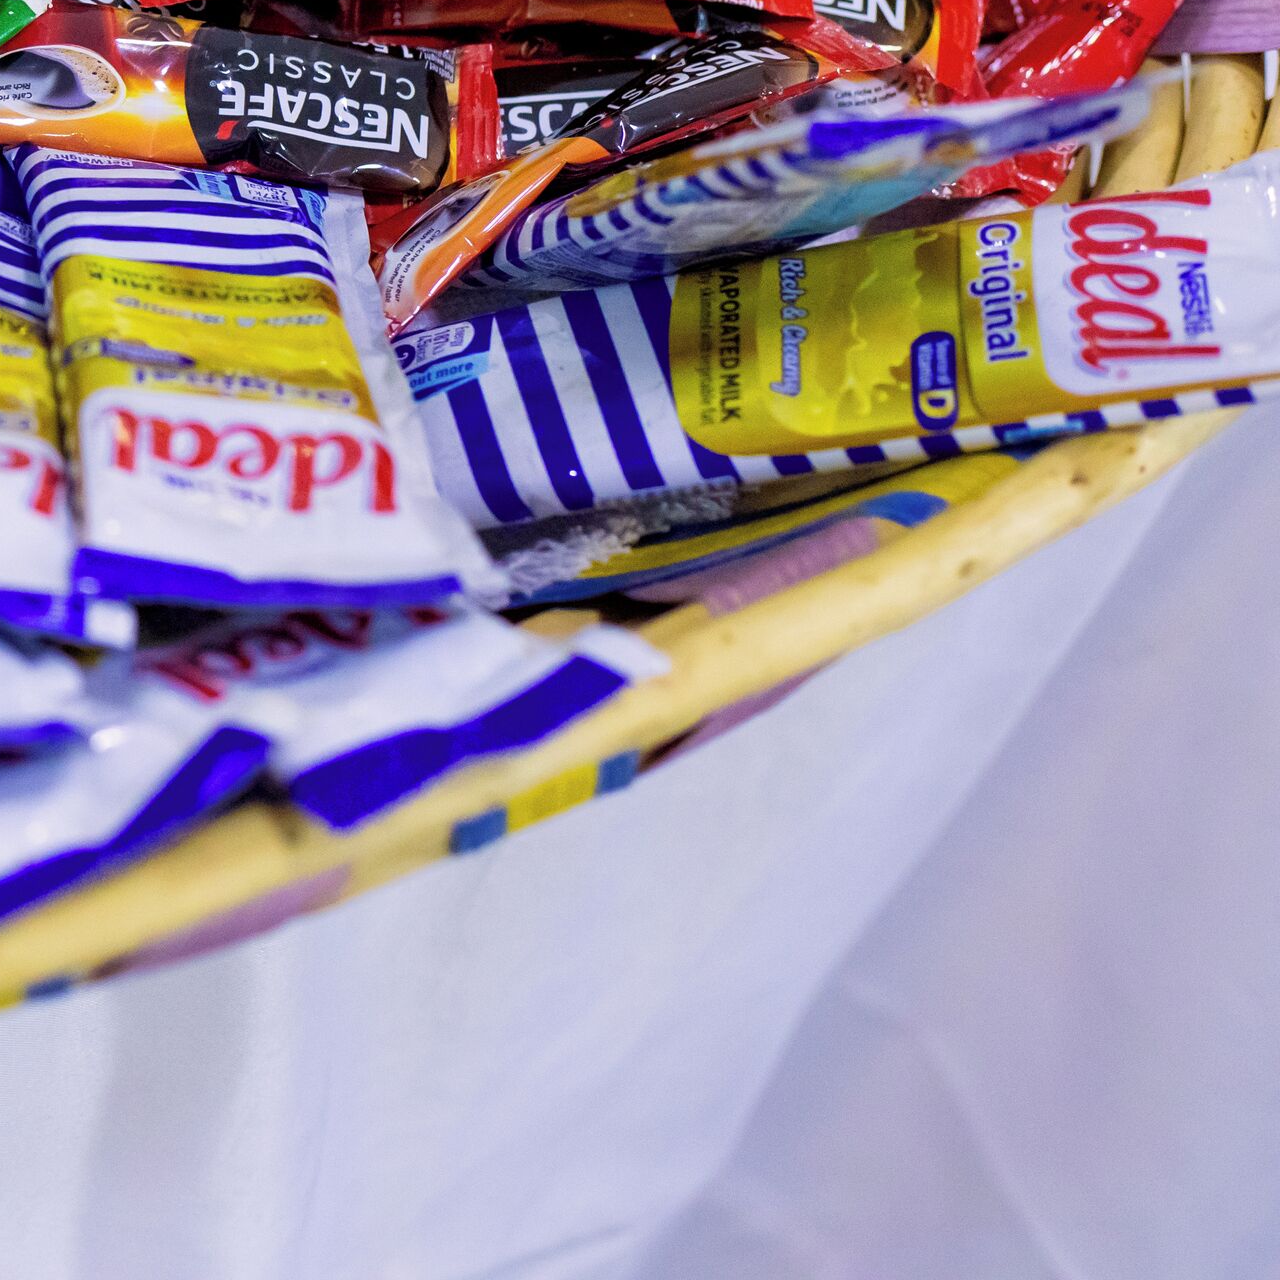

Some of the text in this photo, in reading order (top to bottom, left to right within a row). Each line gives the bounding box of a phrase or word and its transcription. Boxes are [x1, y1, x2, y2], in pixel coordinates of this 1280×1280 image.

[11, 90, 34, 102] Café
[12, 81, 32, 91] Rich
[237, 48, 416, 101] CLASSIC
[778, 256, 807, 312] Rich
[969, 221, 1030, 363] Original
[1060, 188, 1223, 380] Ideal
[433, 360, 475, 379] more
[719, 372, 743, 423] MILK
[109, 402, 400, 517] Ideal
